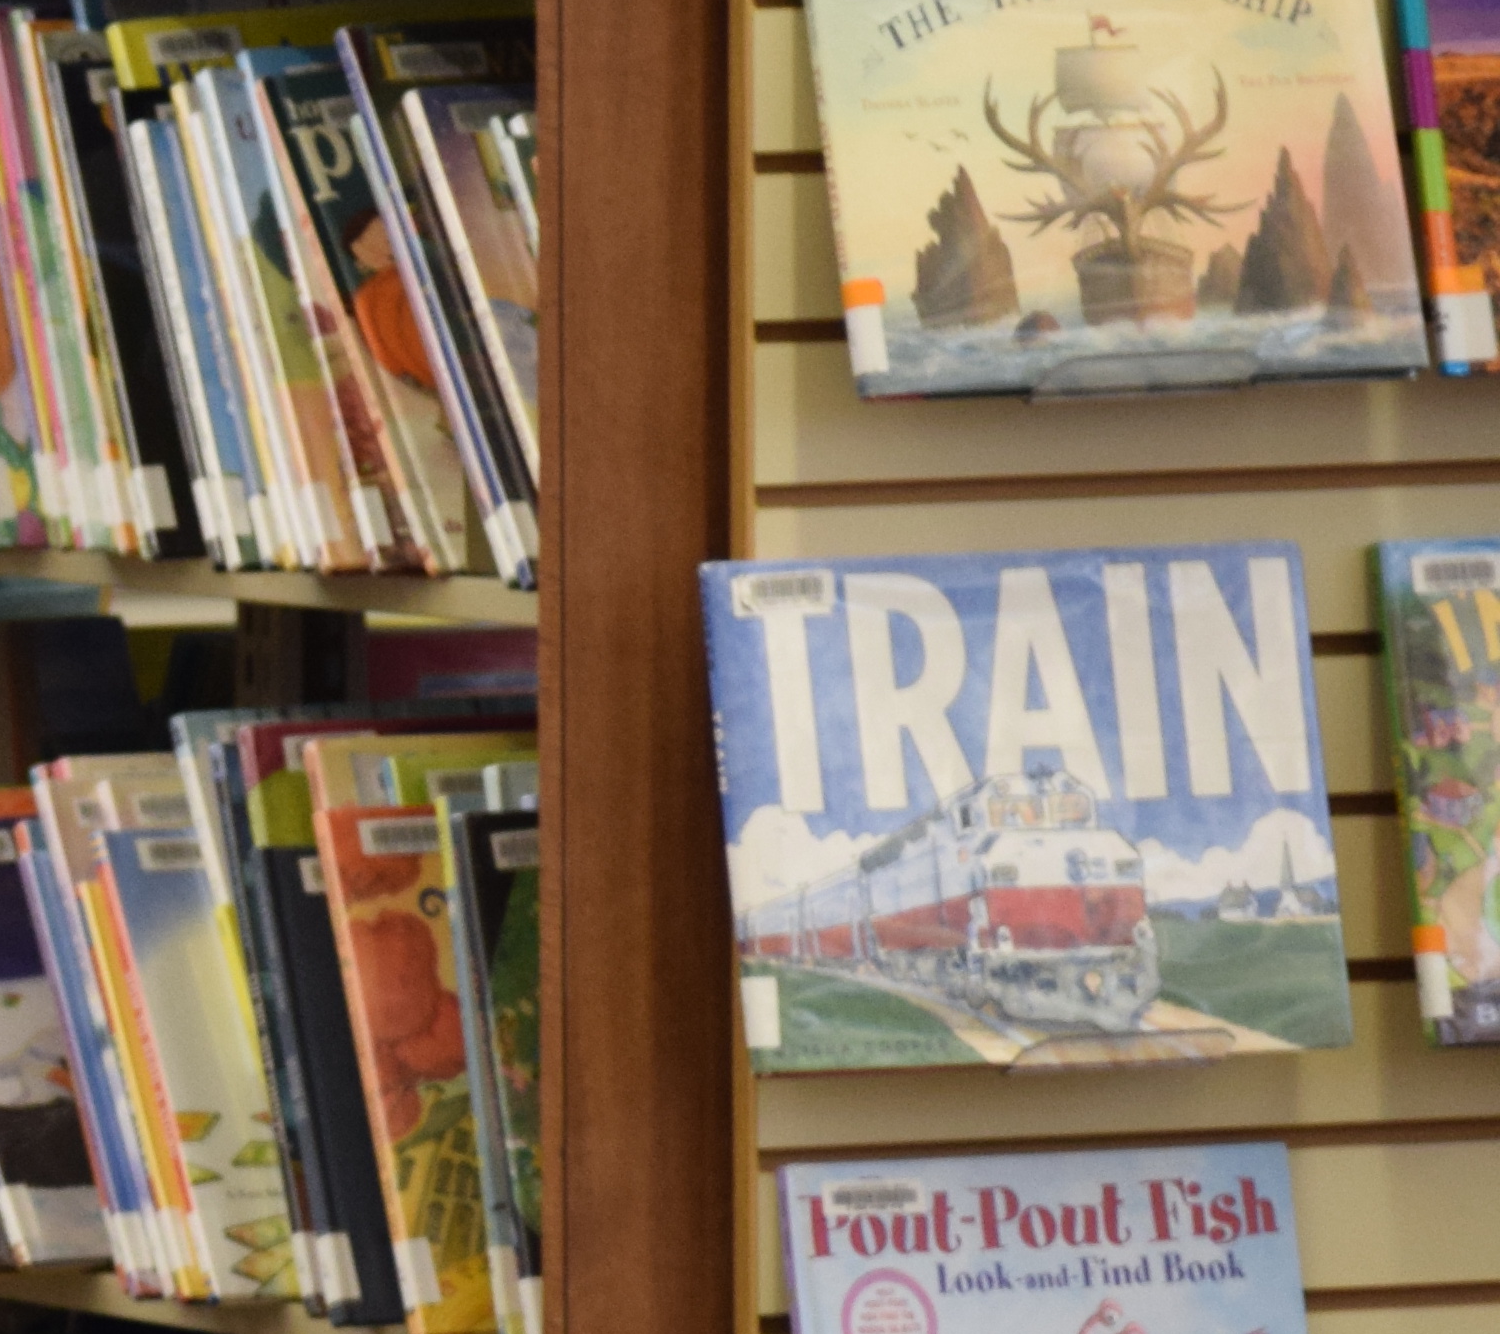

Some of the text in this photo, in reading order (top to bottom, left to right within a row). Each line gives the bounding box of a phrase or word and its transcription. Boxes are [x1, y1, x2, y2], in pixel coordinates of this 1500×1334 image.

[735, 557, 1311, 814] TRAIN
[1145, 1175, 1280, 1250] Fish
[936, 1250, 1247, 1296] Look-and-Find Book
